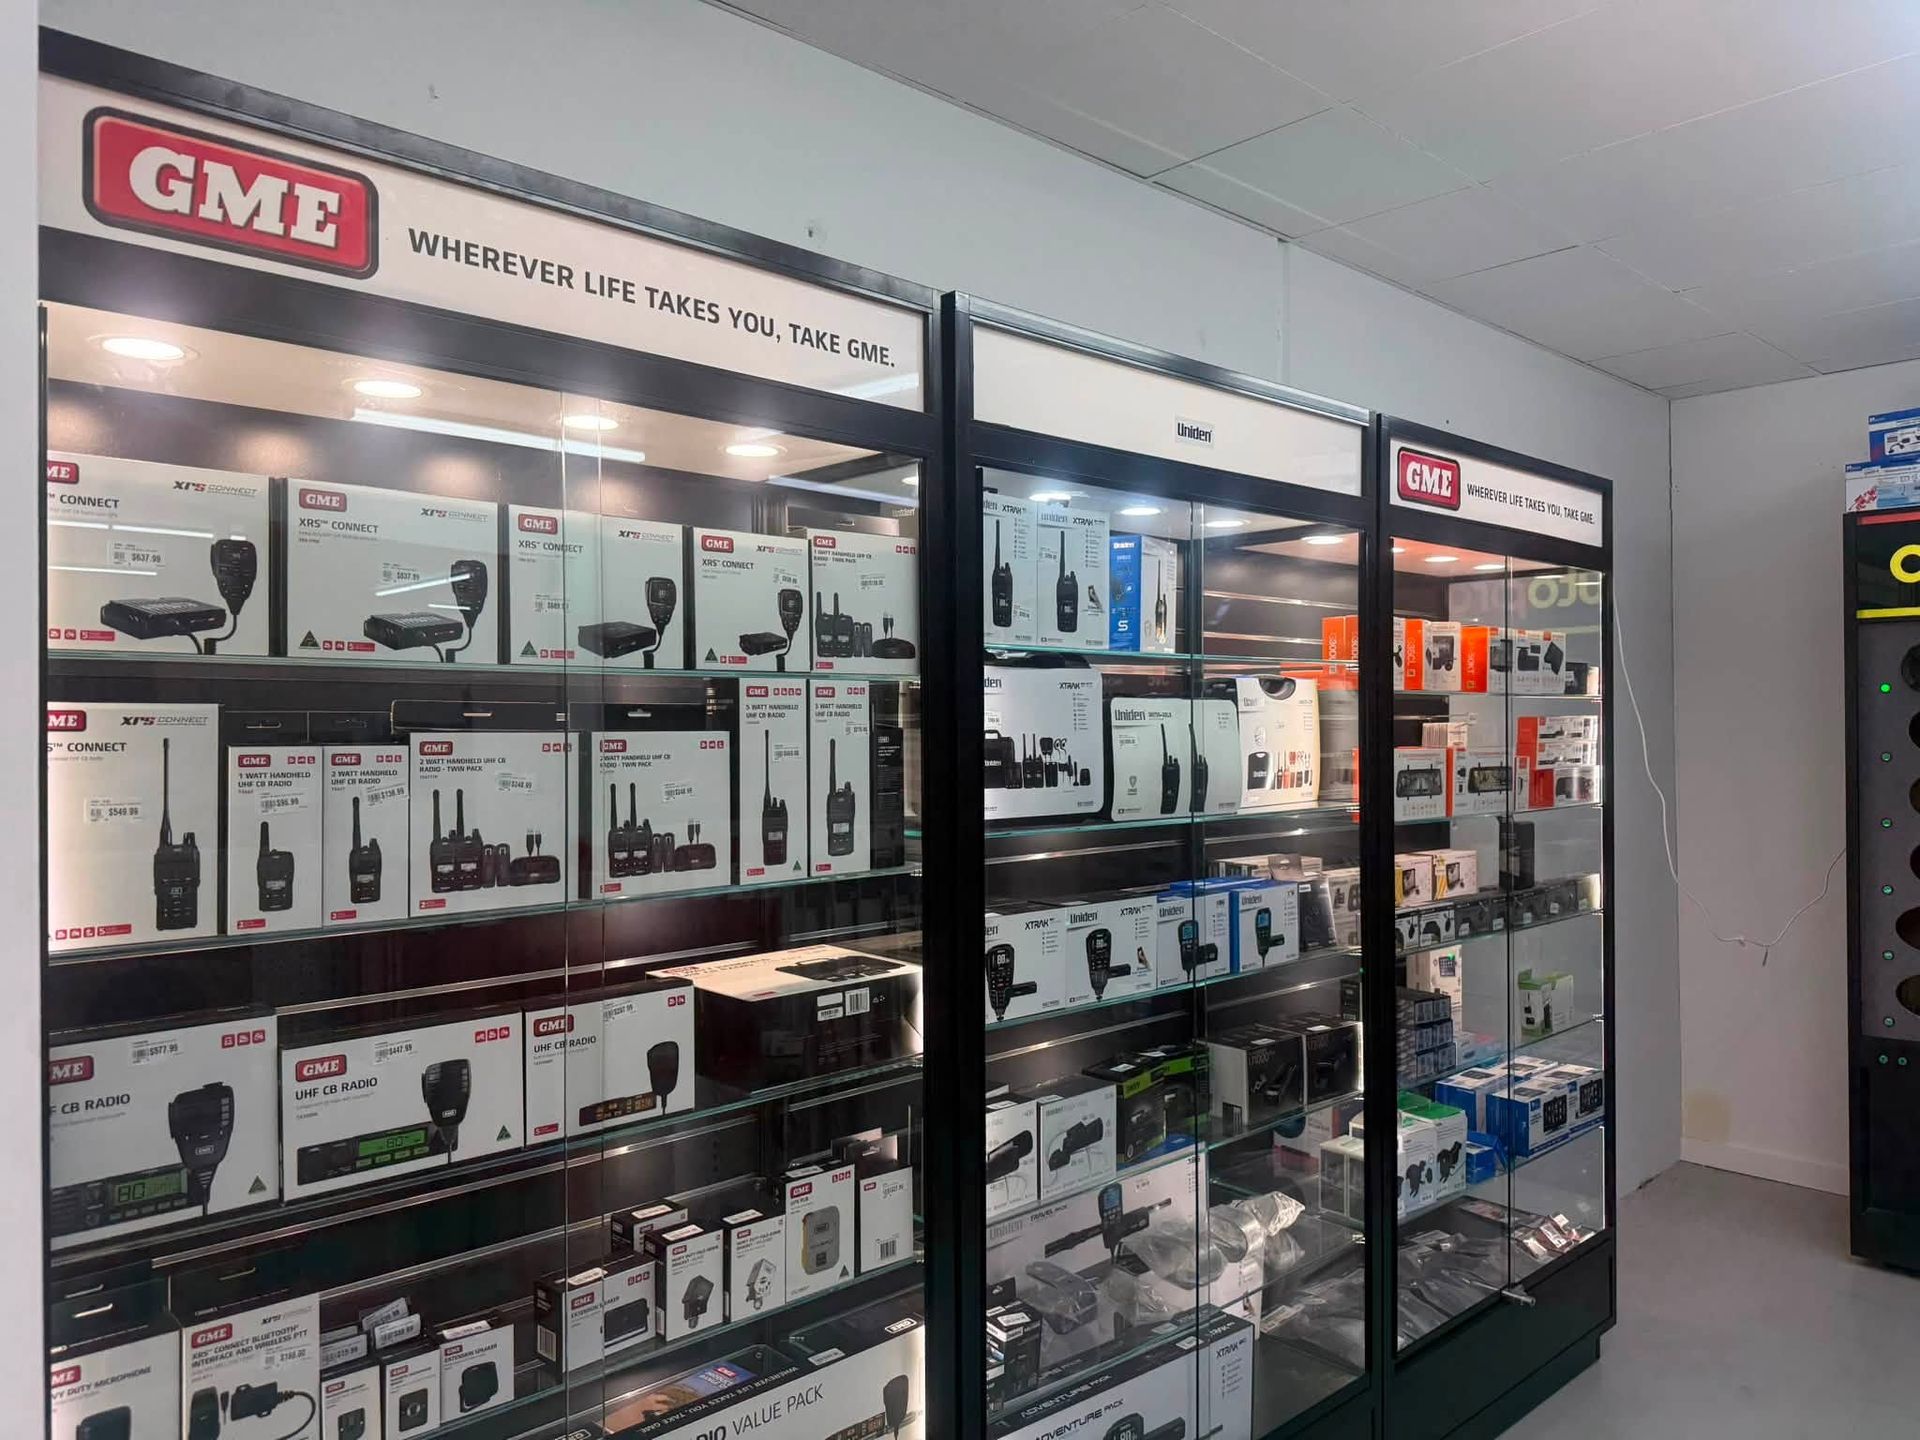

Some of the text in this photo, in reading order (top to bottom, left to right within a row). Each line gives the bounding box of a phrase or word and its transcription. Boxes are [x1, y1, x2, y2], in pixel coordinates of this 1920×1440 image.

[129, 146, 341, 249] GME
[408, 227, 896, 368] WHEREVER LIFE TAKES YOU, TAKE GME.
[1177, 422, 1213, 443] Uniden
[48, 466, 71, 479] ME
[1405, 460, 1453, 498] GME
[60, 493, 119, 508] CONNECT
[305, 492, 340, 507] GME
[1466, 483, 1596, 525] WHEREVER LIFE TAKES YOU, TAKE GME.
[331, 520, 379, 534] CONNECT
[523, 518, 552, 530] GME
[543, 542, 584, 554] CONNECT
[705, 539, 729, 551] GME
[816, 538, 834, 547] GME
[722, 560, 754, 570] CONNECT
[984, 676, 1002, 689] den
[748, 687, 766, 696] GME
[817, 688, 833, 697] GME
[768, 703, 799, 711] HANDHELD
[48, 714, 78, 727] ME
[1114, 708, 1146, 721] Uniden
[67, 742, 127, 753] CONNECT
[423, 744, 449, 753] GME
[242, 757, 267, 766] GME
[334, 755, 357, 764] GME
[245, 771, 268, 779] WATT
[269, 771, 311, 779] HANDHELD
[338, 770, 358, 778] WATT
[360, 769, 398, 777] HANDHELD
[238, 780, 253, 788] UHF
[268, 779, 293, 787] RADIO
[1241, 895, 1262, 906] Uniden
[1070, 911, 1098, 925] Uniden
[1159, 905, 1185, 918] Uniden
[533, 1035, 597, 1053] UHF CB RADIO
[51, 1061, 84, 1081] ME
[302, 1058, 340, 1077] GME
[295, 1077, 378, 1101] UHF CB RADIO
[61, 1093, 131, 1115] CB RADIO
[792, 1184, 811, 1198] GME
[989, 1220, 1023, 1242] Uniden
[196, 1326, 228, 1344] GME
[191, 1328, 309, 1368] INTERFACE AND WIRELESS PTT
[214, 1338, 250, 1355] CONNECT
[52, 1370, 76, 1386] ME
[67, 1383, 92, 1397] DUTY
[94, 1365, 152, 1389] MICROPHONE
[732, 1405, 783, 1433] VALUE
[785, 1383, 824, 1414] PACK
[1021, 1384, 1092, 1418] ADVENTURE
